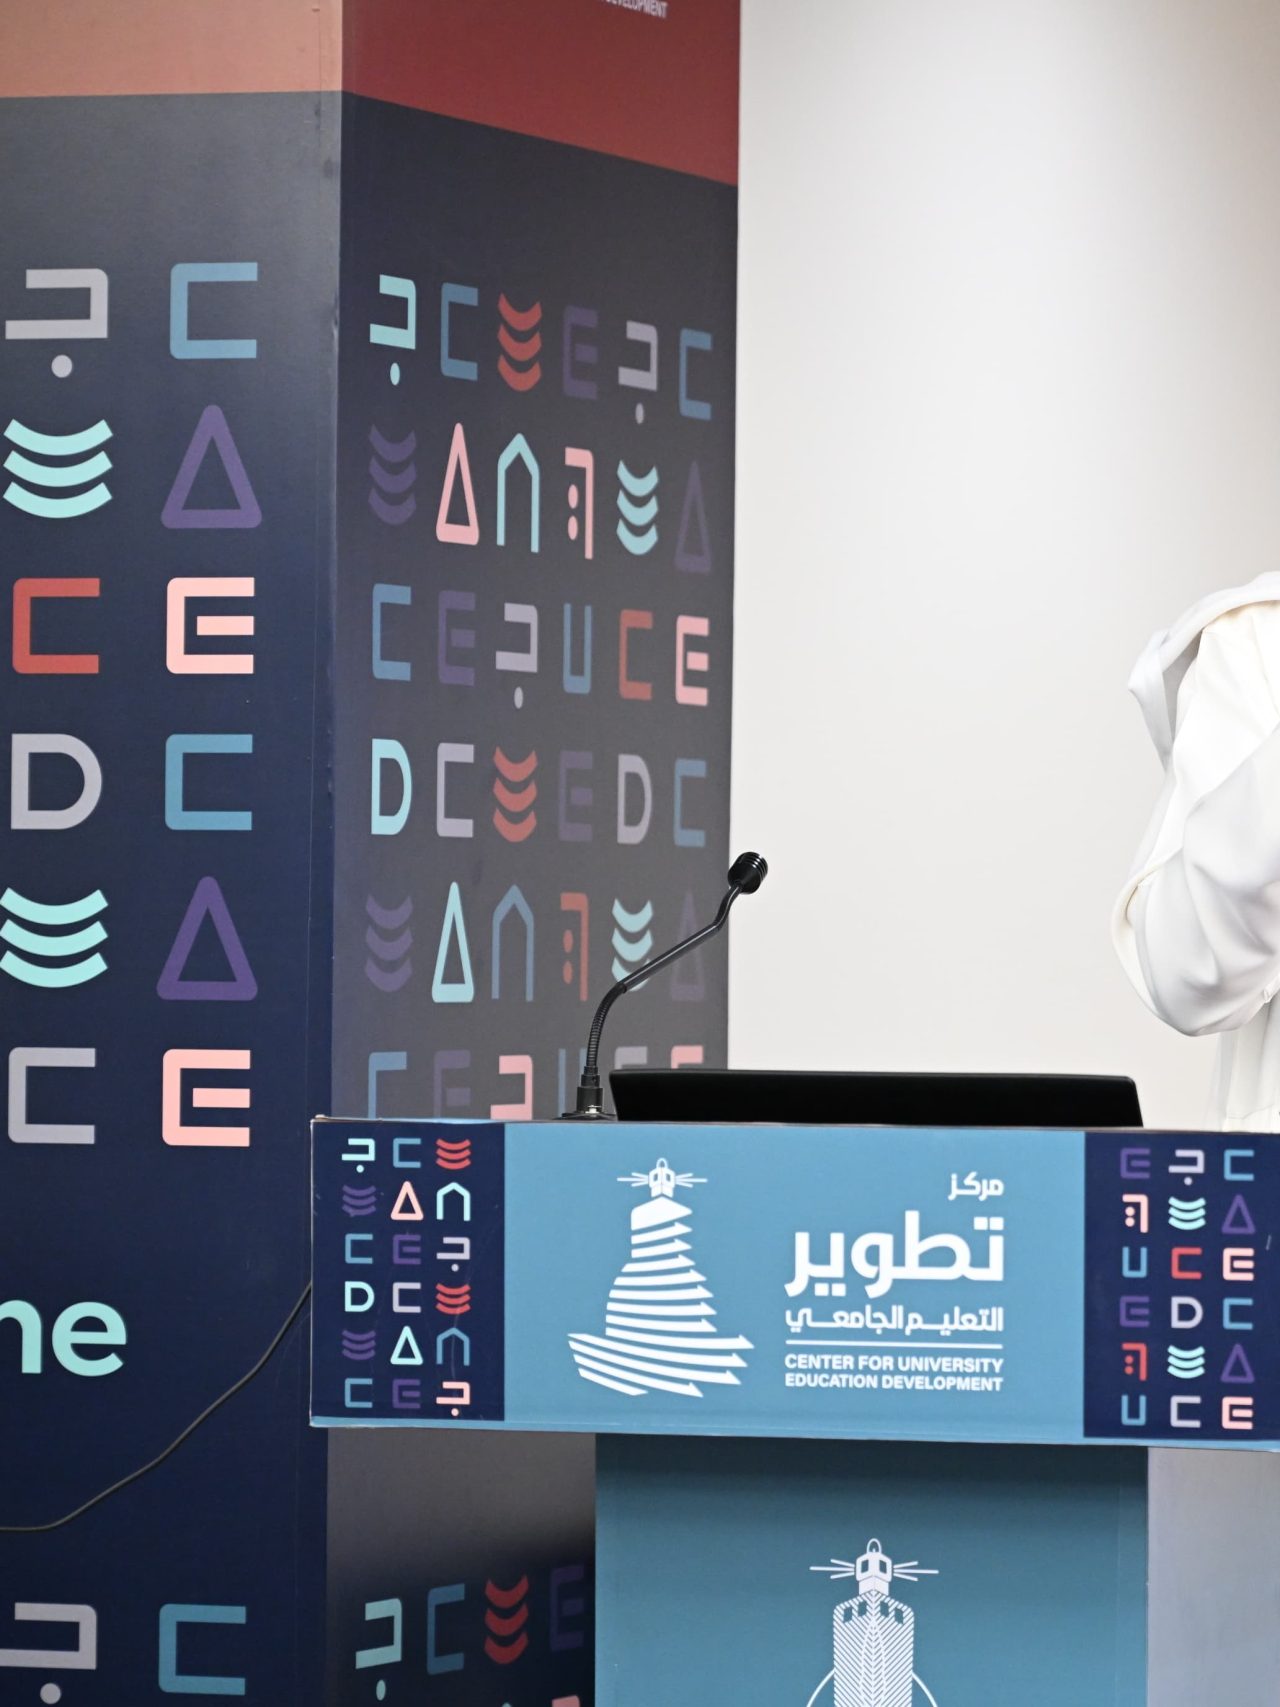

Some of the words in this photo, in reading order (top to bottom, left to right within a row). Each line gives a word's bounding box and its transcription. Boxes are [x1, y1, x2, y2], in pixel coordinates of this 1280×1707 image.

[947, 1171, 1004, 1201] مركز
[784, 1210, 1004, 1298] تطوير
[785, 1303, 904, 1335] الجامعي
[905, 1305, 1004, 1336] التعليم
[784, 1353, 855, 1371] CENTER
[858, 1355, 894, 1371] FOR
[897, 1355, 1004, 1374] UNIVERSITY
[784, 1373, 879, 1389] EDUCATION
[881, 1375, 1004, 1392] DEVELOPMENT
